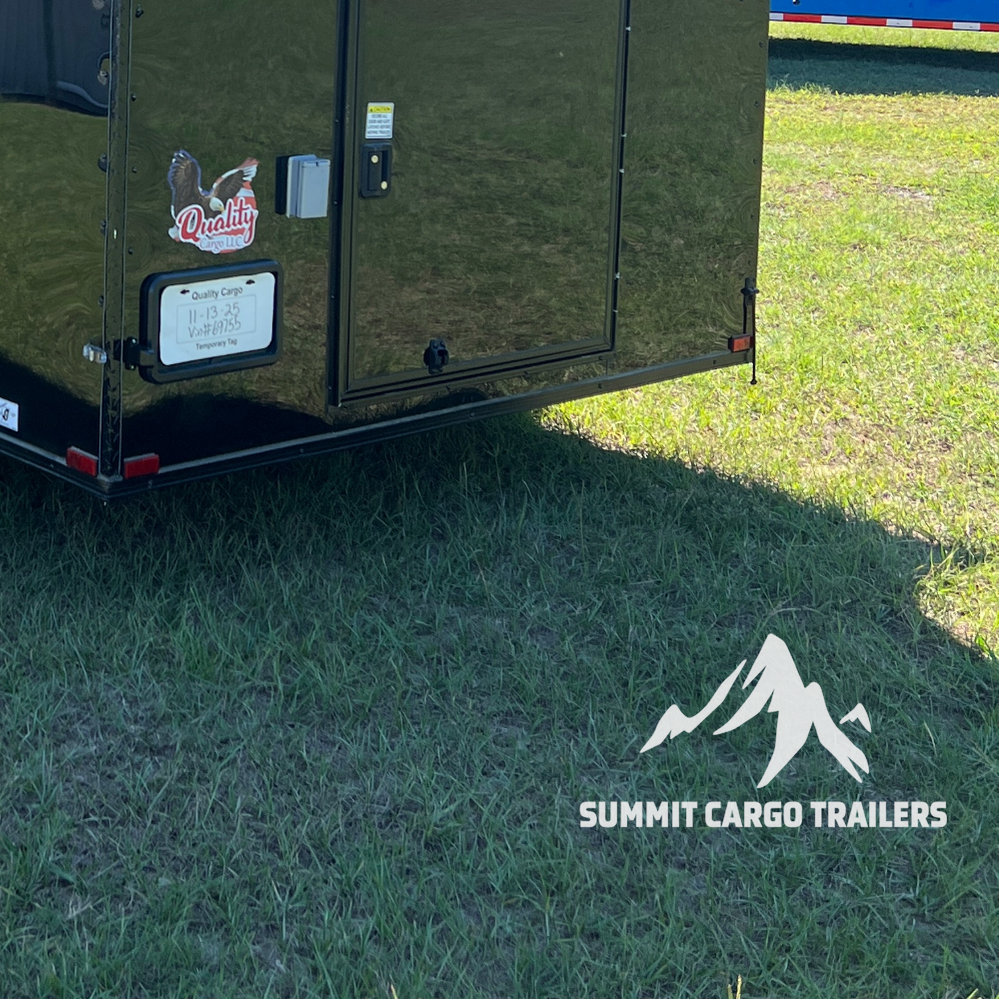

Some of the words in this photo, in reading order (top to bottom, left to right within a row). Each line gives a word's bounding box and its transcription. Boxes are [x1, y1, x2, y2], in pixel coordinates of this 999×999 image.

[178, 199, 255, 244] Quality
[200, 238, 224, 252] Cargo
[192, 289, 219, 299] Quality
[221, 286, 243, 297] Cargo
[196, 339, 226, 350] Temporary
[228, 338, 237, 346] Tag
